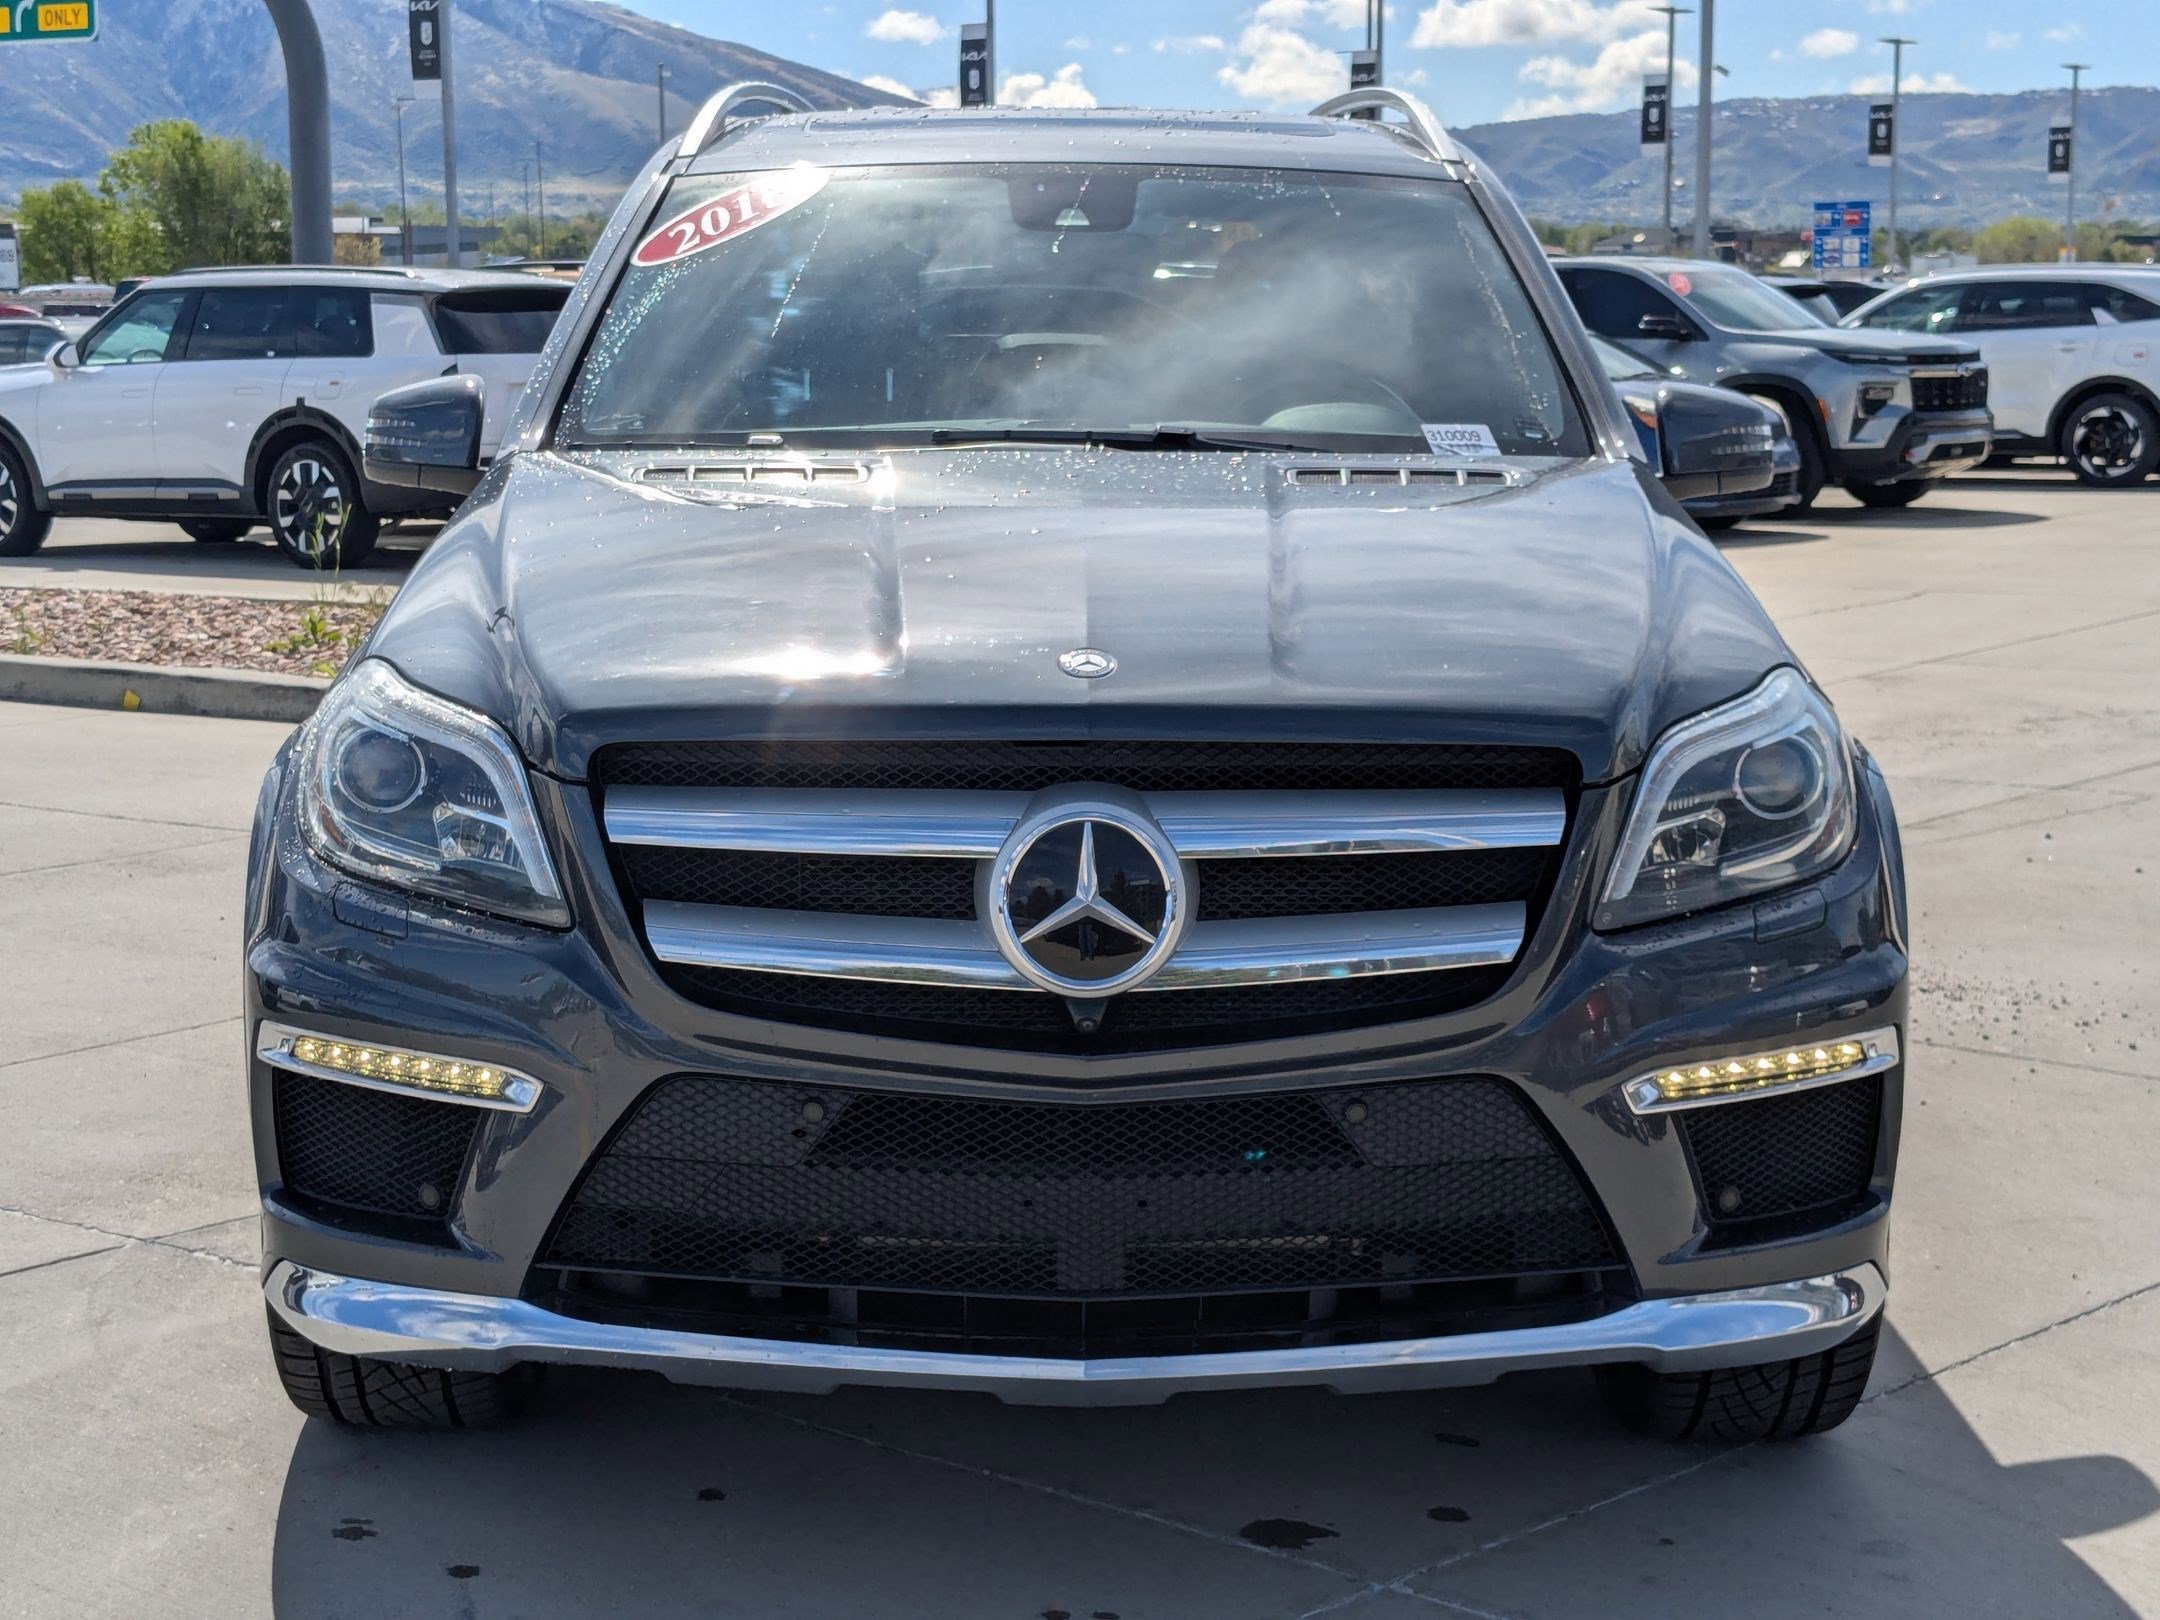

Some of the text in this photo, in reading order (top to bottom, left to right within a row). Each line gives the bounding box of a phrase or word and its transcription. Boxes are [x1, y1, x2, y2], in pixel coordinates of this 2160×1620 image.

[44, 8, 82, 26] ONLY
[668, 184, 786, 255] 201
[1426, 430, 1482, 442] 310009
